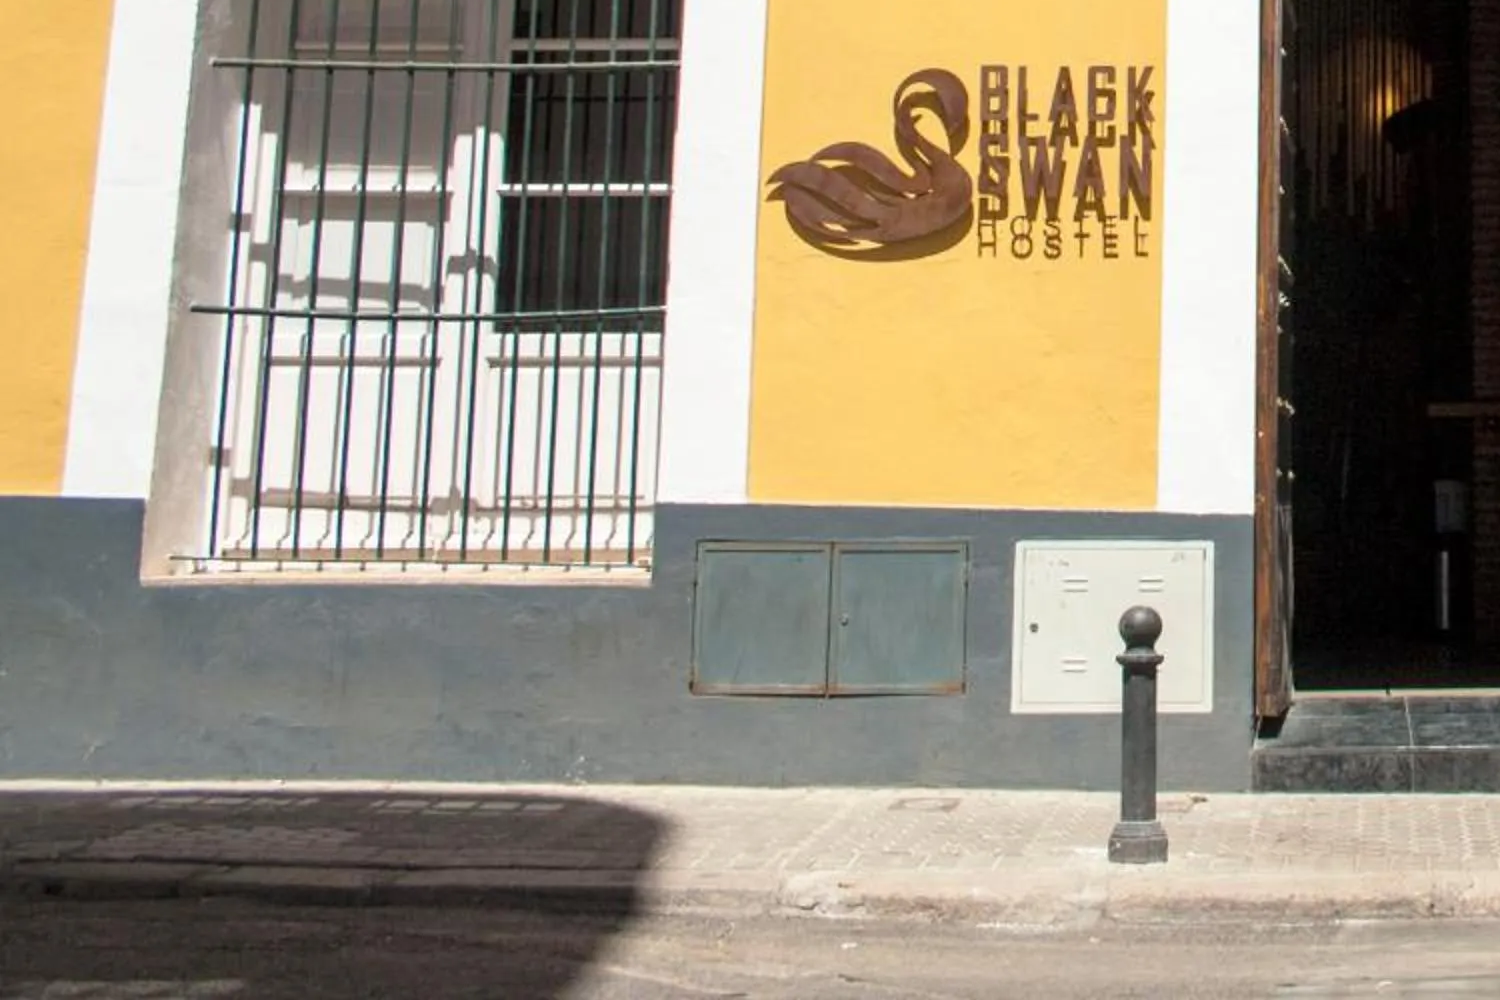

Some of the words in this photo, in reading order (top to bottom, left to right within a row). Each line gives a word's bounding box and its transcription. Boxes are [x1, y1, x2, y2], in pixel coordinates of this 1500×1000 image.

[979, 65, 1155, 131] BLACK
[978, 134, 1152, 210] SWAN
[977, 214, 1149, 254] HOSTEL
